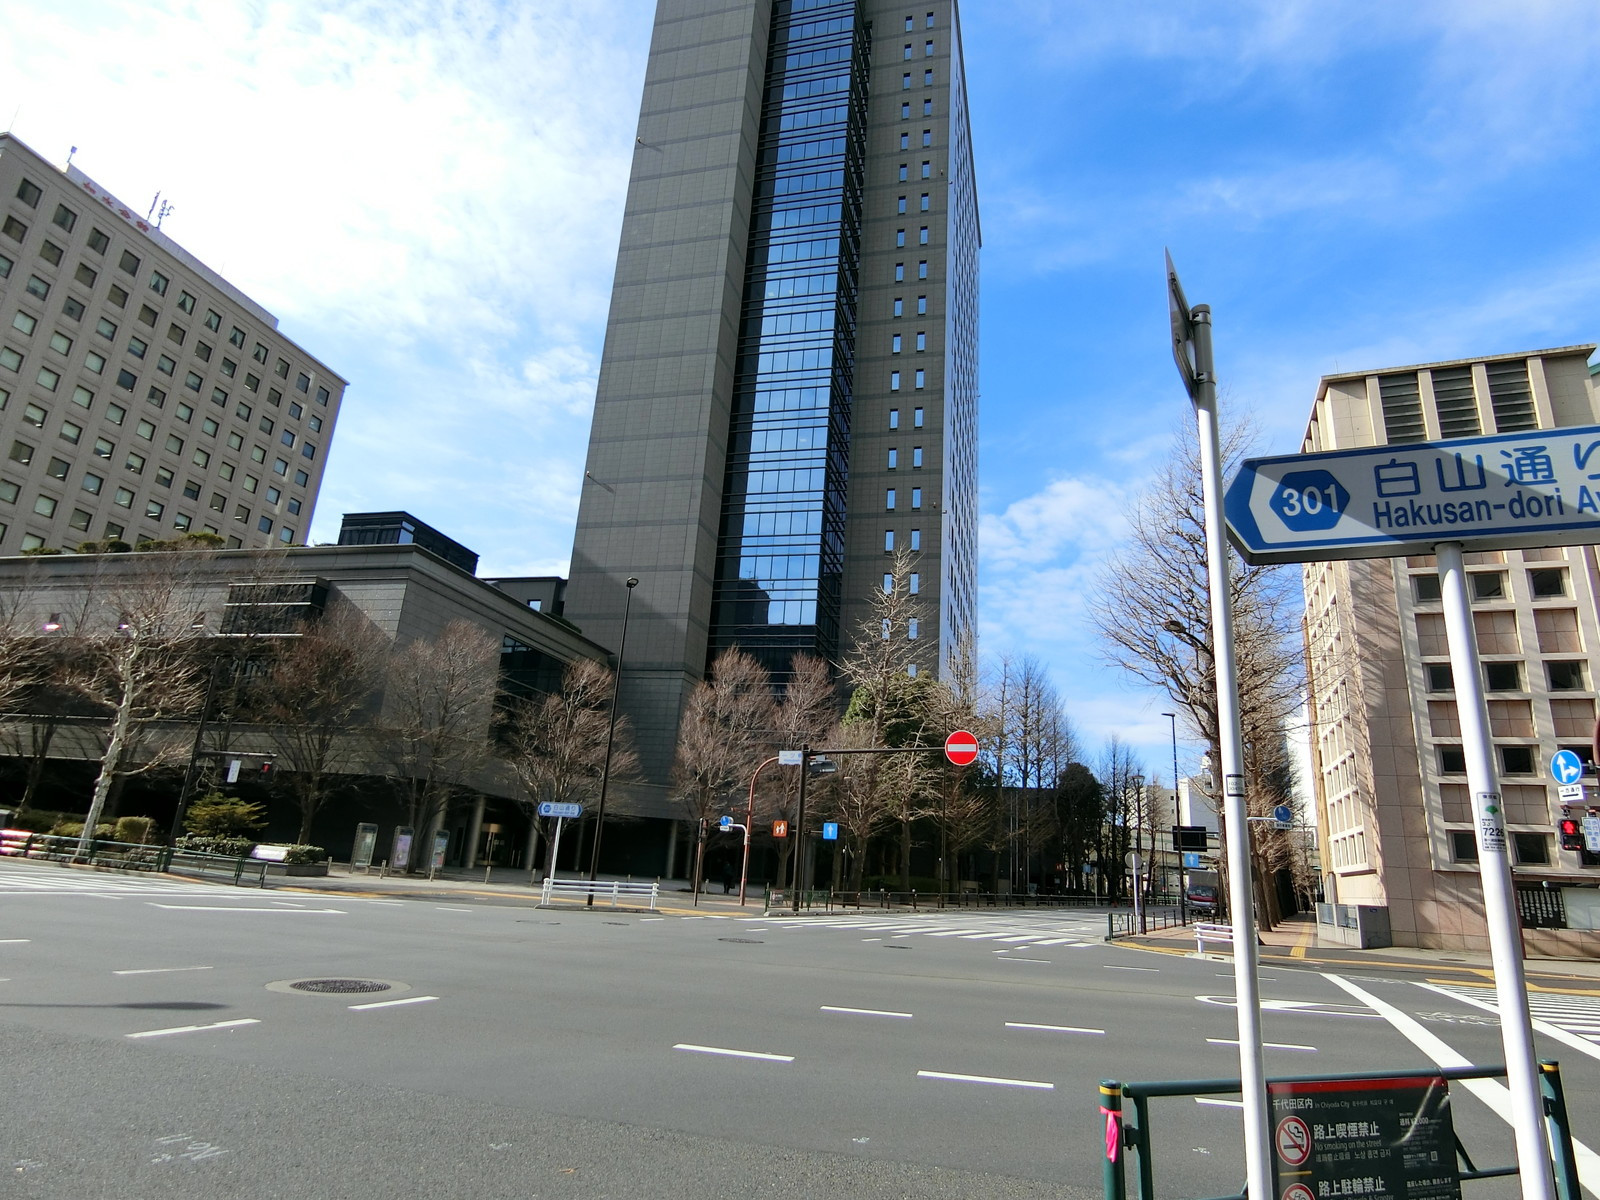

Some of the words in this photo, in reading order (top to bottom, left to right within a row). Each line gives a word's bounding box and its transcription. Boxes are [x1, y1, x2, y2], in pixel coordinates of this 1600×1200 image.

[1282, 484, 1338, 517] 301
[1373, 487, 1564, 529] Hakusan-dori
[1272, 1098, 1313, 1110] 千代田区内
[1340, 1100, 1350, 1108] City
[1313, 1120, 1380, 1140] 路上喫煙禁止
[1314, 1142, 1323, 1151] No
[1324, 1141, 1347, 1151] smoking
[1348, 1141, 1357, 1149] on
[1356, 1140, 1365, 1148] the
[1366, 1139, 1381, 1148] street
[1318, 1176, 1386, 1197] 路上駐輪禁止
